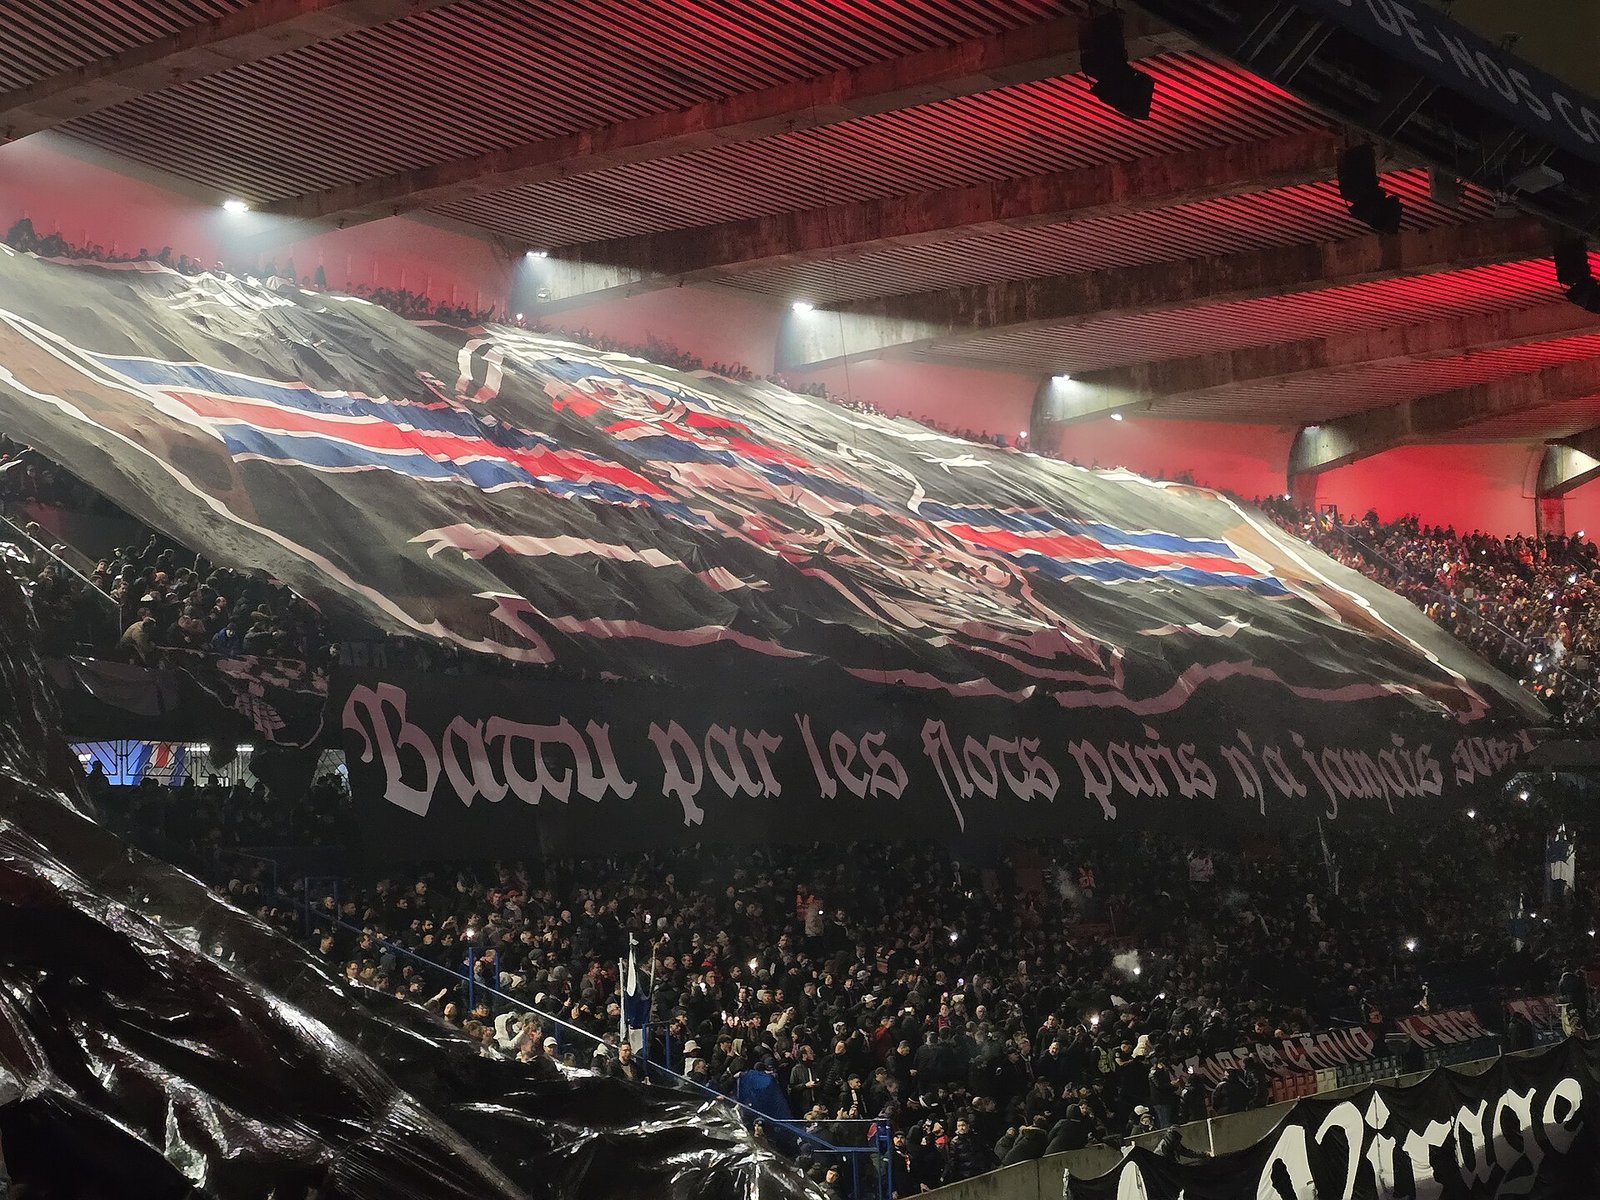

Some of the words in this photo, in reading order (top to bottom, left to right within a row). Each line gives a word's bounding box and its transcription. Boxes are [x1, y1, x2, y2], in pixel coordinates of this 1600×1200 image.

[1433, 25, 1552, 122] NOS
[647, 719, 784, 827] par
[794, 712, 909, 800] les
[920, 718, 1061, 832] flots
[1068, 722, 1218, 821] paris
[1219, 728, 1307, 817] n'a
[1288, 729, 1443, 820] jamais
[1256, 1077, 1584, 1200] Virage
